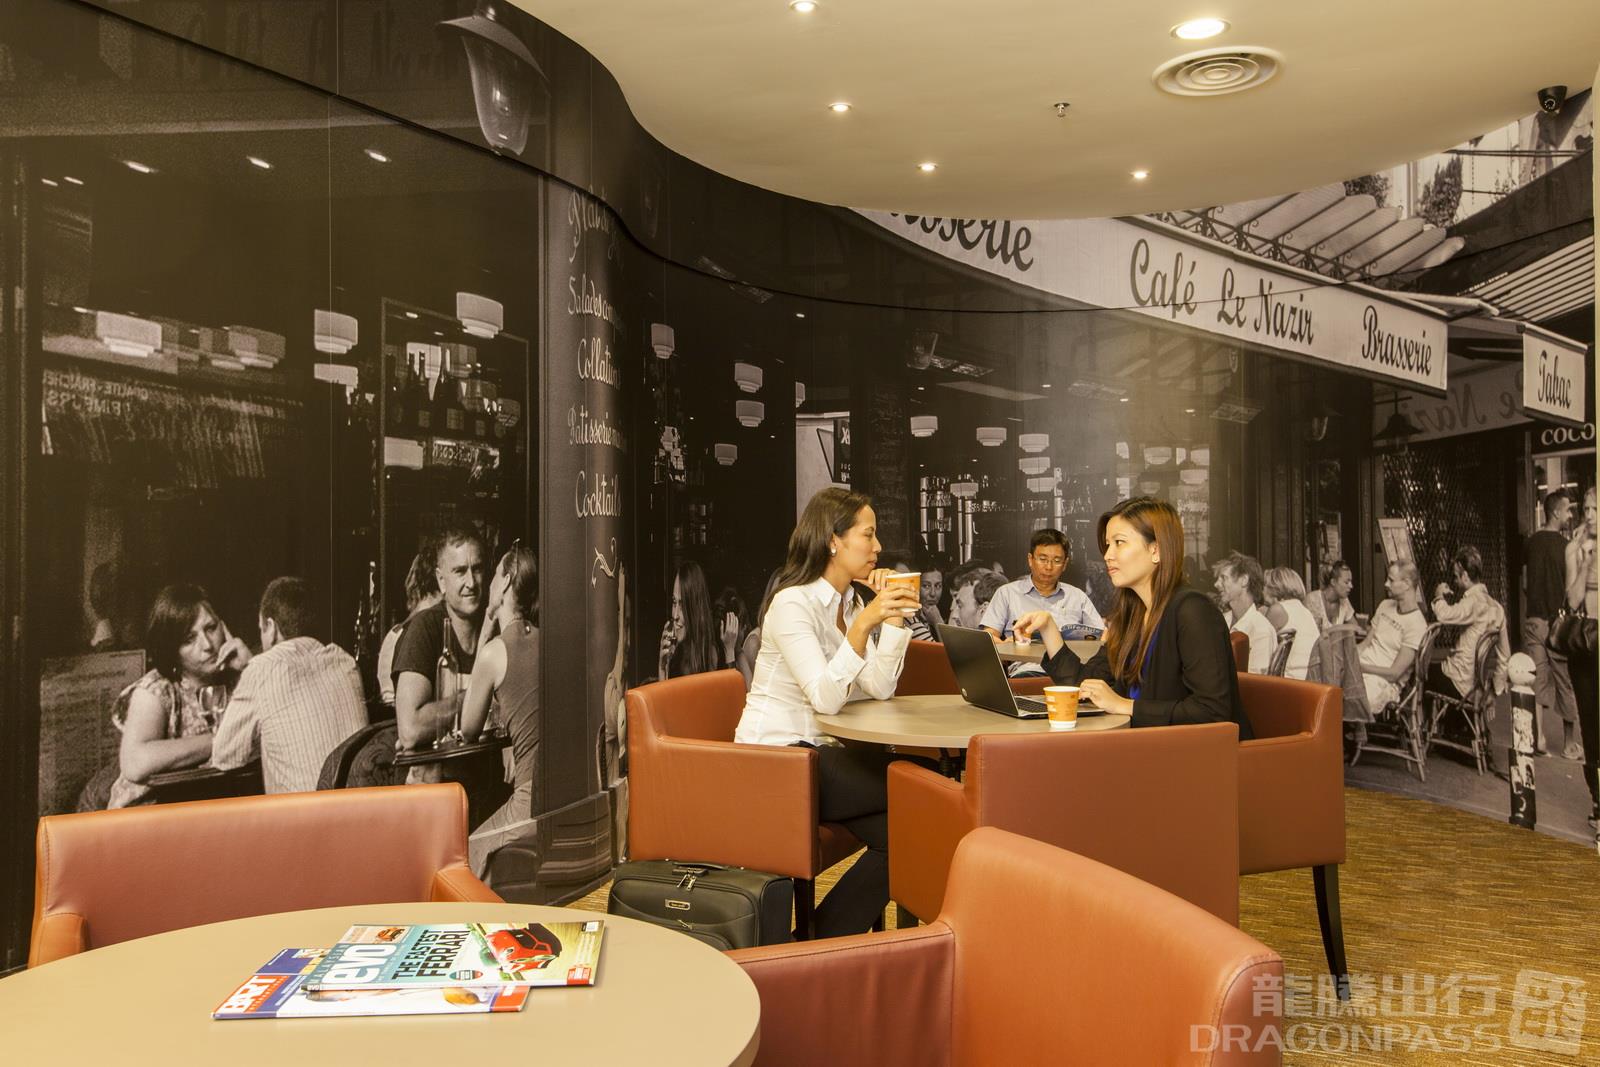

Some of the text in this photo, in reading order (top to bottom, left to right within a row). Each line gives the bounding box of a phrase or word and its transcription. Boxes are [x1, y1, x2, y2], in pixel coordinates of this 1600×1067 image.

[890, 212, 1034, 272] serie
[1130, 238, 1432, 377] Café Le Nazir Brasserie
[1538, 350, 1572, 410] Tabac
[321, 944, 398, 984] evo
[404, 929, 442, 960] FASTEST
[416, 930, 471, 977] FERRARI
[391, 961, 422, 980] THE
